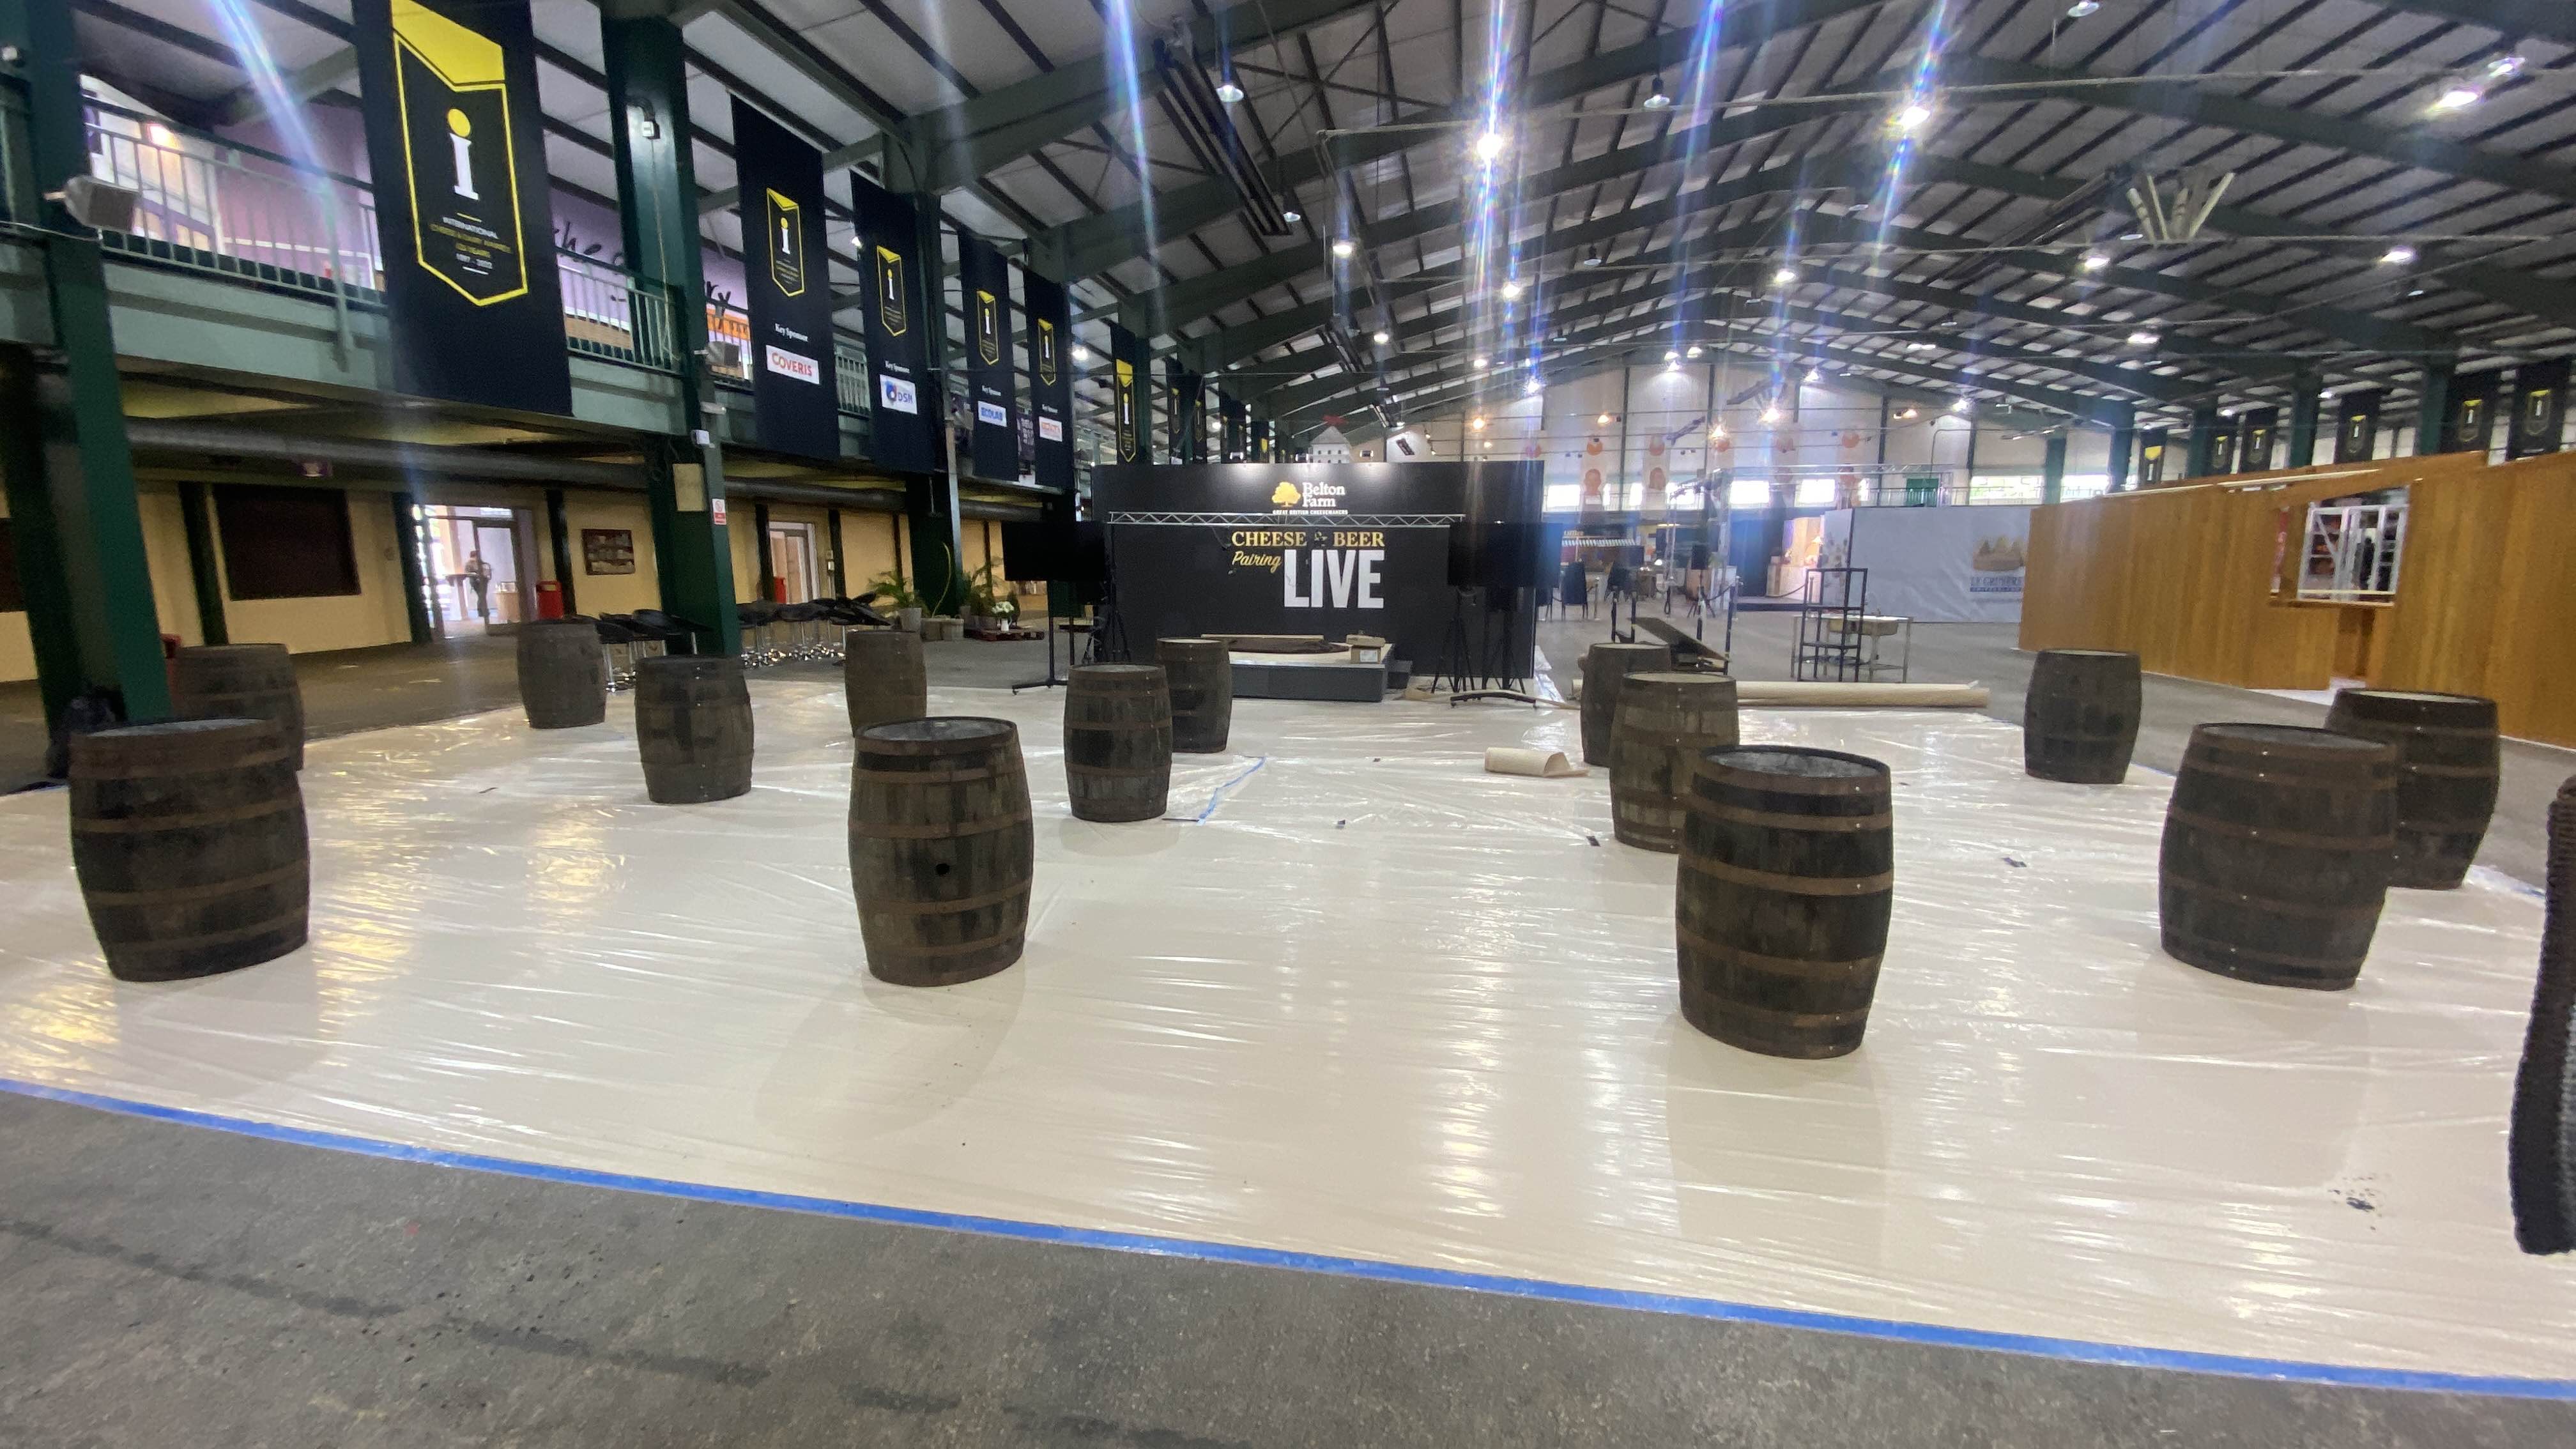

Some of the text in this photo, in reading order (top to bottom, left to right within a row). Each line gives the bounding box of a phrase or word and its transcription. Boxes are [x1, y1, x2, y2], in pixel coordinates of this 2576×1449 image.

[774, 323, 809, 342] Key Sponsor
[772, 352, 813, 376] COVERIS
[1302, 481, 1346, 496] Belton
[1302, 494, 1336, 507] Farm
[1231, 532, 1307, 547] CHEESE
[1333, 532, 1385, 547] BEER
[1232, 550, 1282, 574] Pairing
[1284, 549, 1384, 608] LIVE
